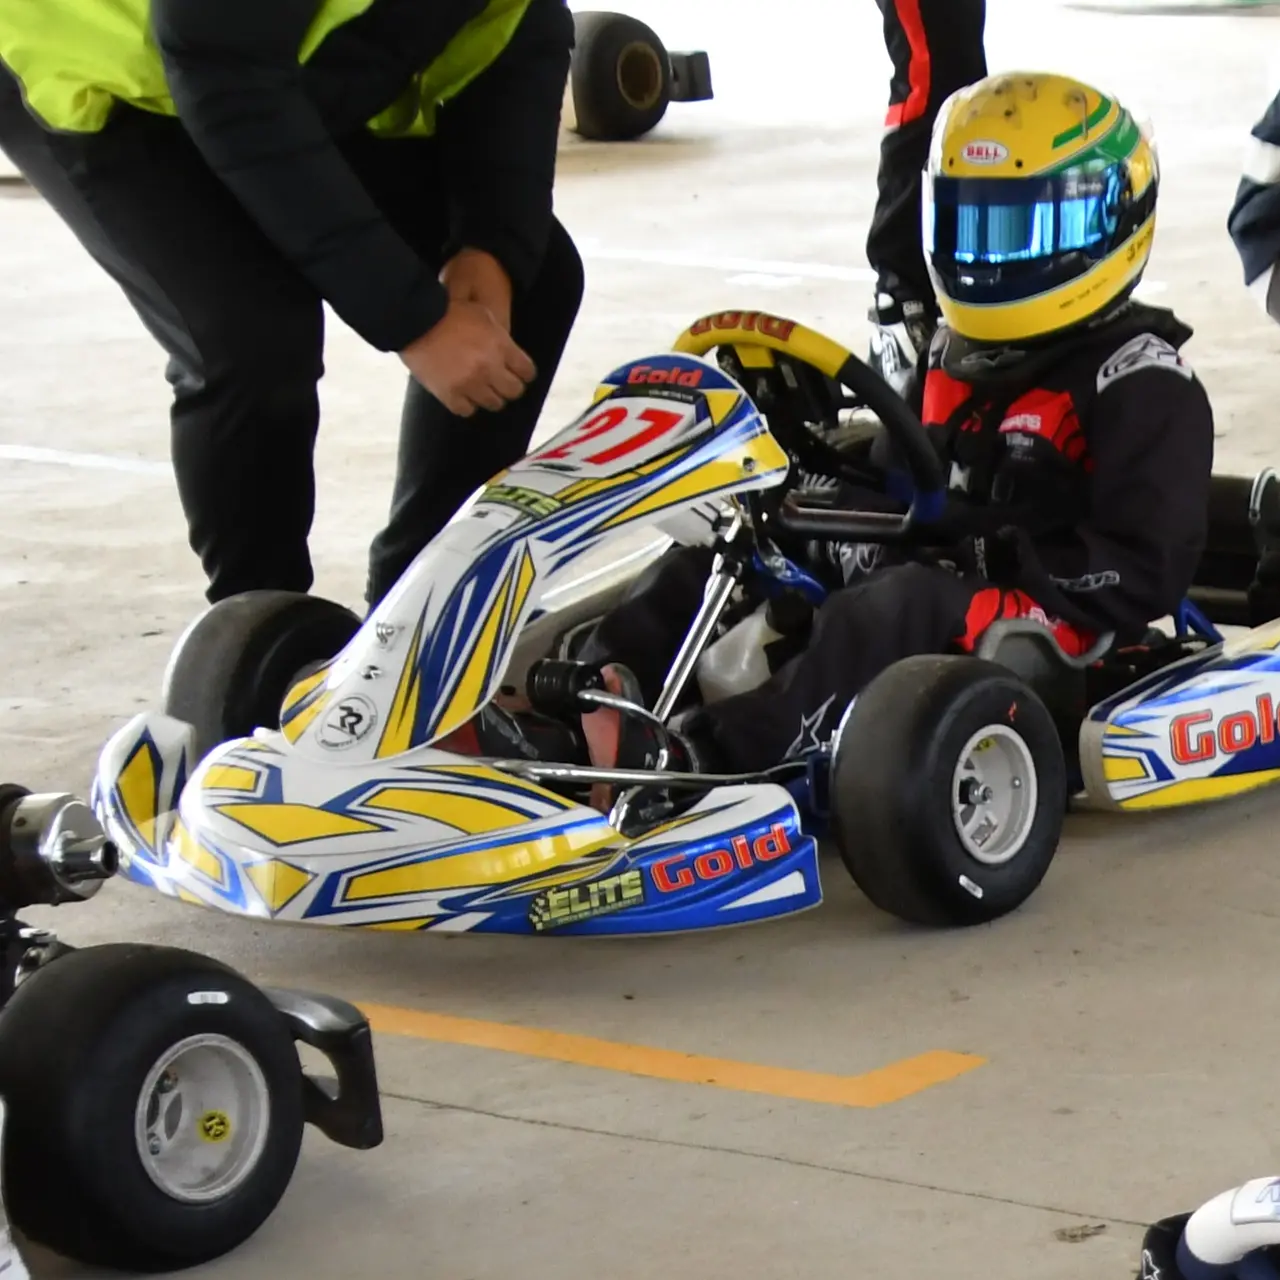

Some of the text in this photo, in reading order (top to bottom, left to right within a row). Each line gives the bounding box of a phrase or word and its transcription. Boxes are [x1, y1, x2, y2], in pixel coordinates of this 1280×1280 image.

[626, 365, 704, 389] Gold
[527, 405, 686, 467] 27
[651, 821, 792, 894] Gold
[549, 868, 643, 919] ELITE
